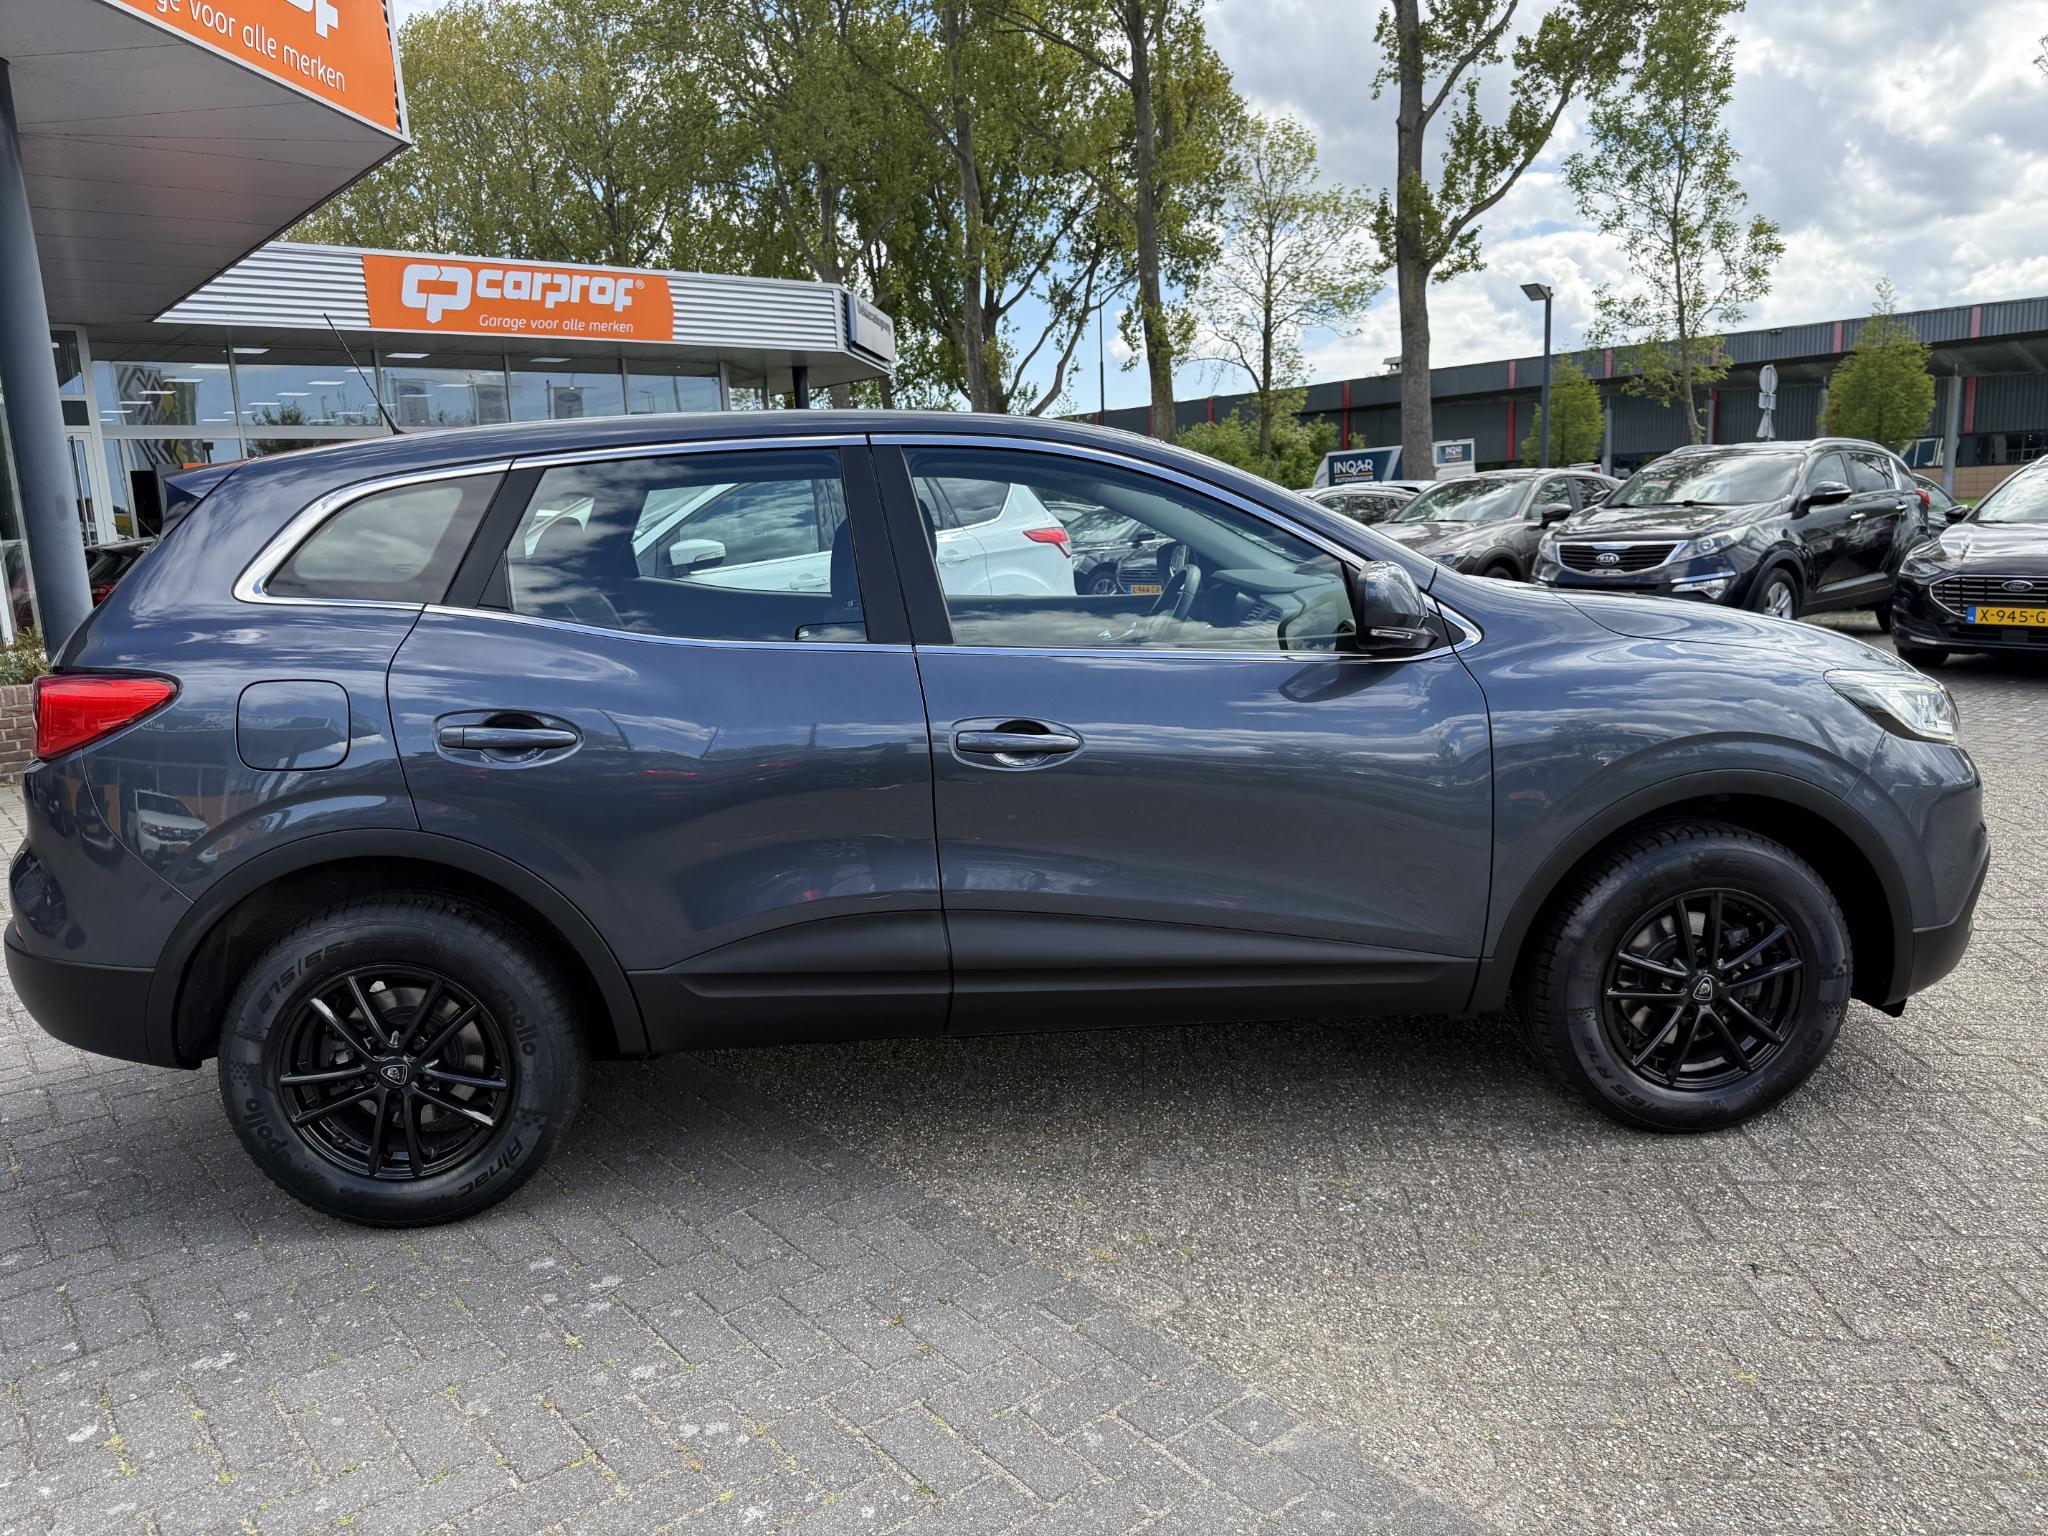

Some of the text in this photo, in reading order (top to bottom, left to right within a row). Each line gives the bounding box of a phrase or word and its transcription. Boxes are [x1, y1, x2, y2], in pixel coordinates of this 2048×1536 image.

[188, 0, 236, 38] voor
[242, 23, 277, 59] alle
[283, 44, 345, 93] merken
[479, 314, 634, 333] Garage voor alle merken
[1334, 459, 1373, 474] INQAR
